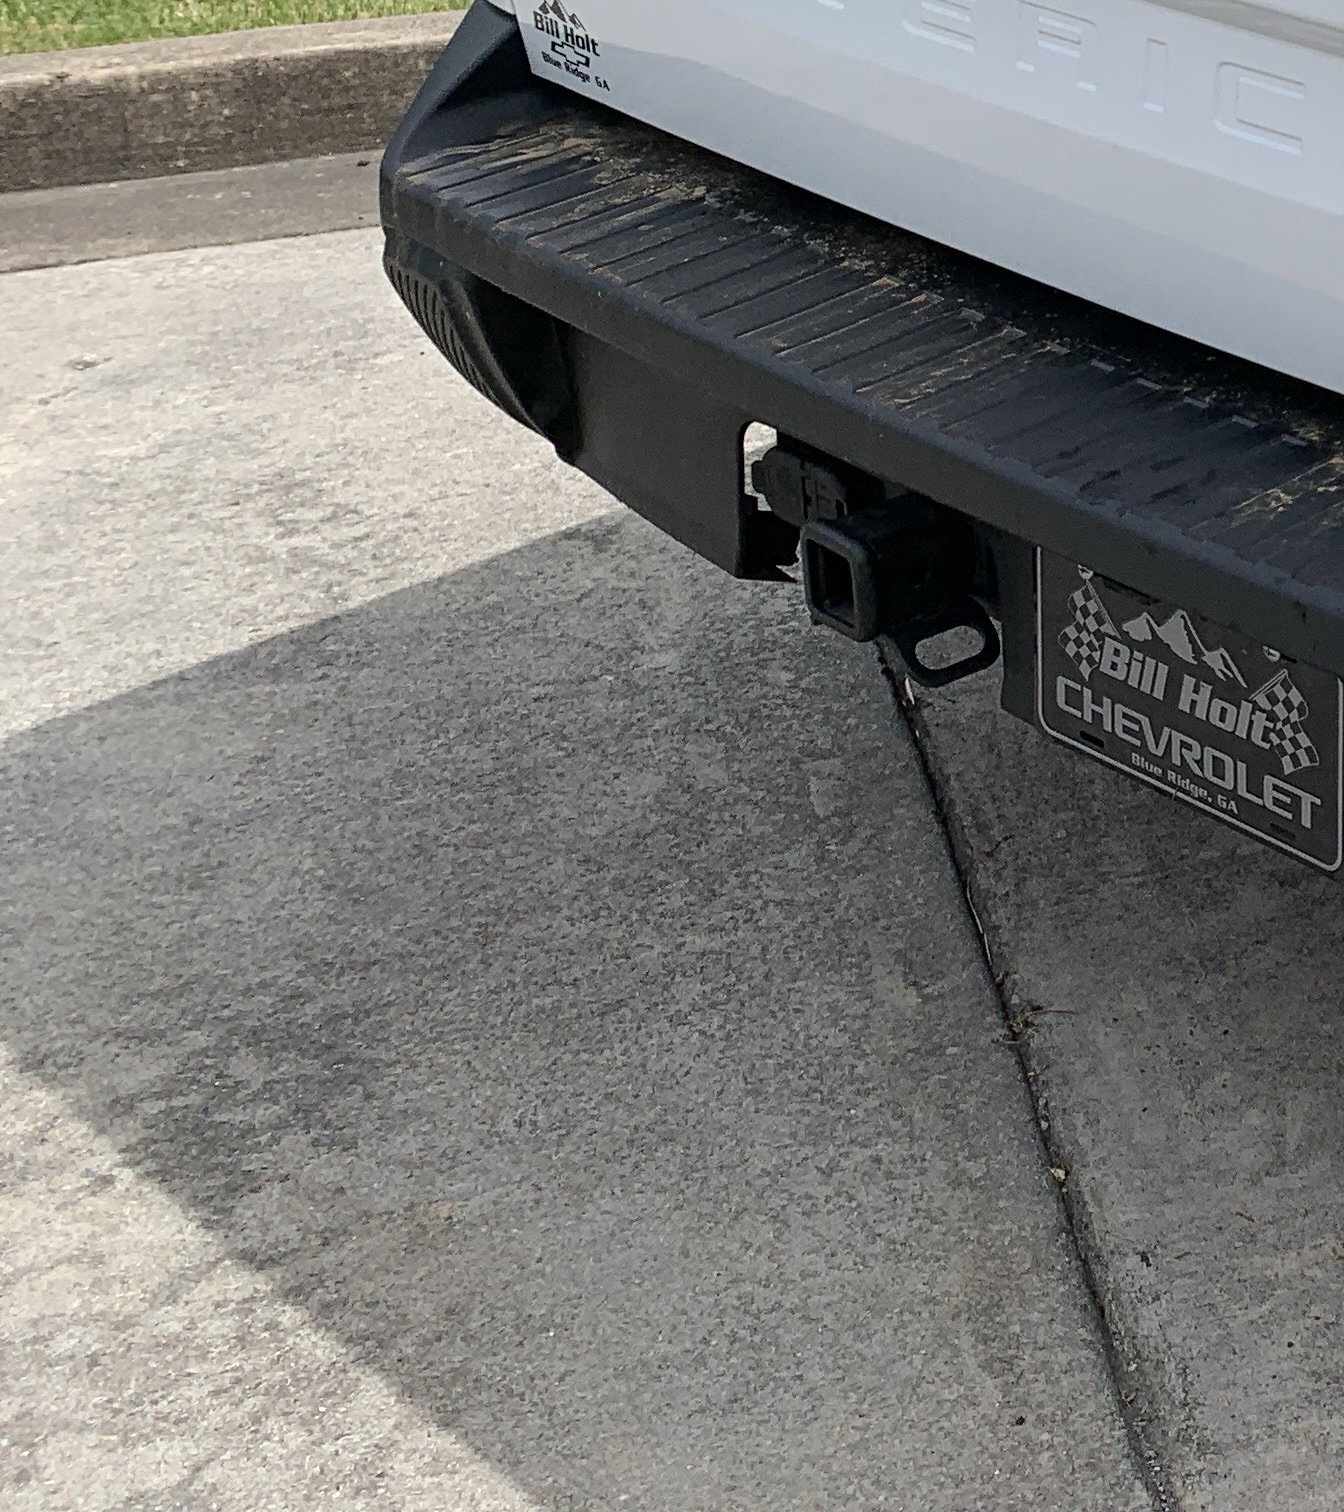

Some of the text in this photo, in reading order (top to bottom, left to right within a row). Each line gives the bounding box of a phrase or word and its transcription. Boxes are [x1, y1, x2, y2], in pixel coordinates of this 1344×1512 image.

[533, 10, 600, 57] Bill Holt
[1099, 636, 1275, 750] Bill Holt
[1056, 675, 1321, 830] CHEVROLET
[1131, 751, 1164, 781] Blue
[1217, 793, 1239, 816] GA
